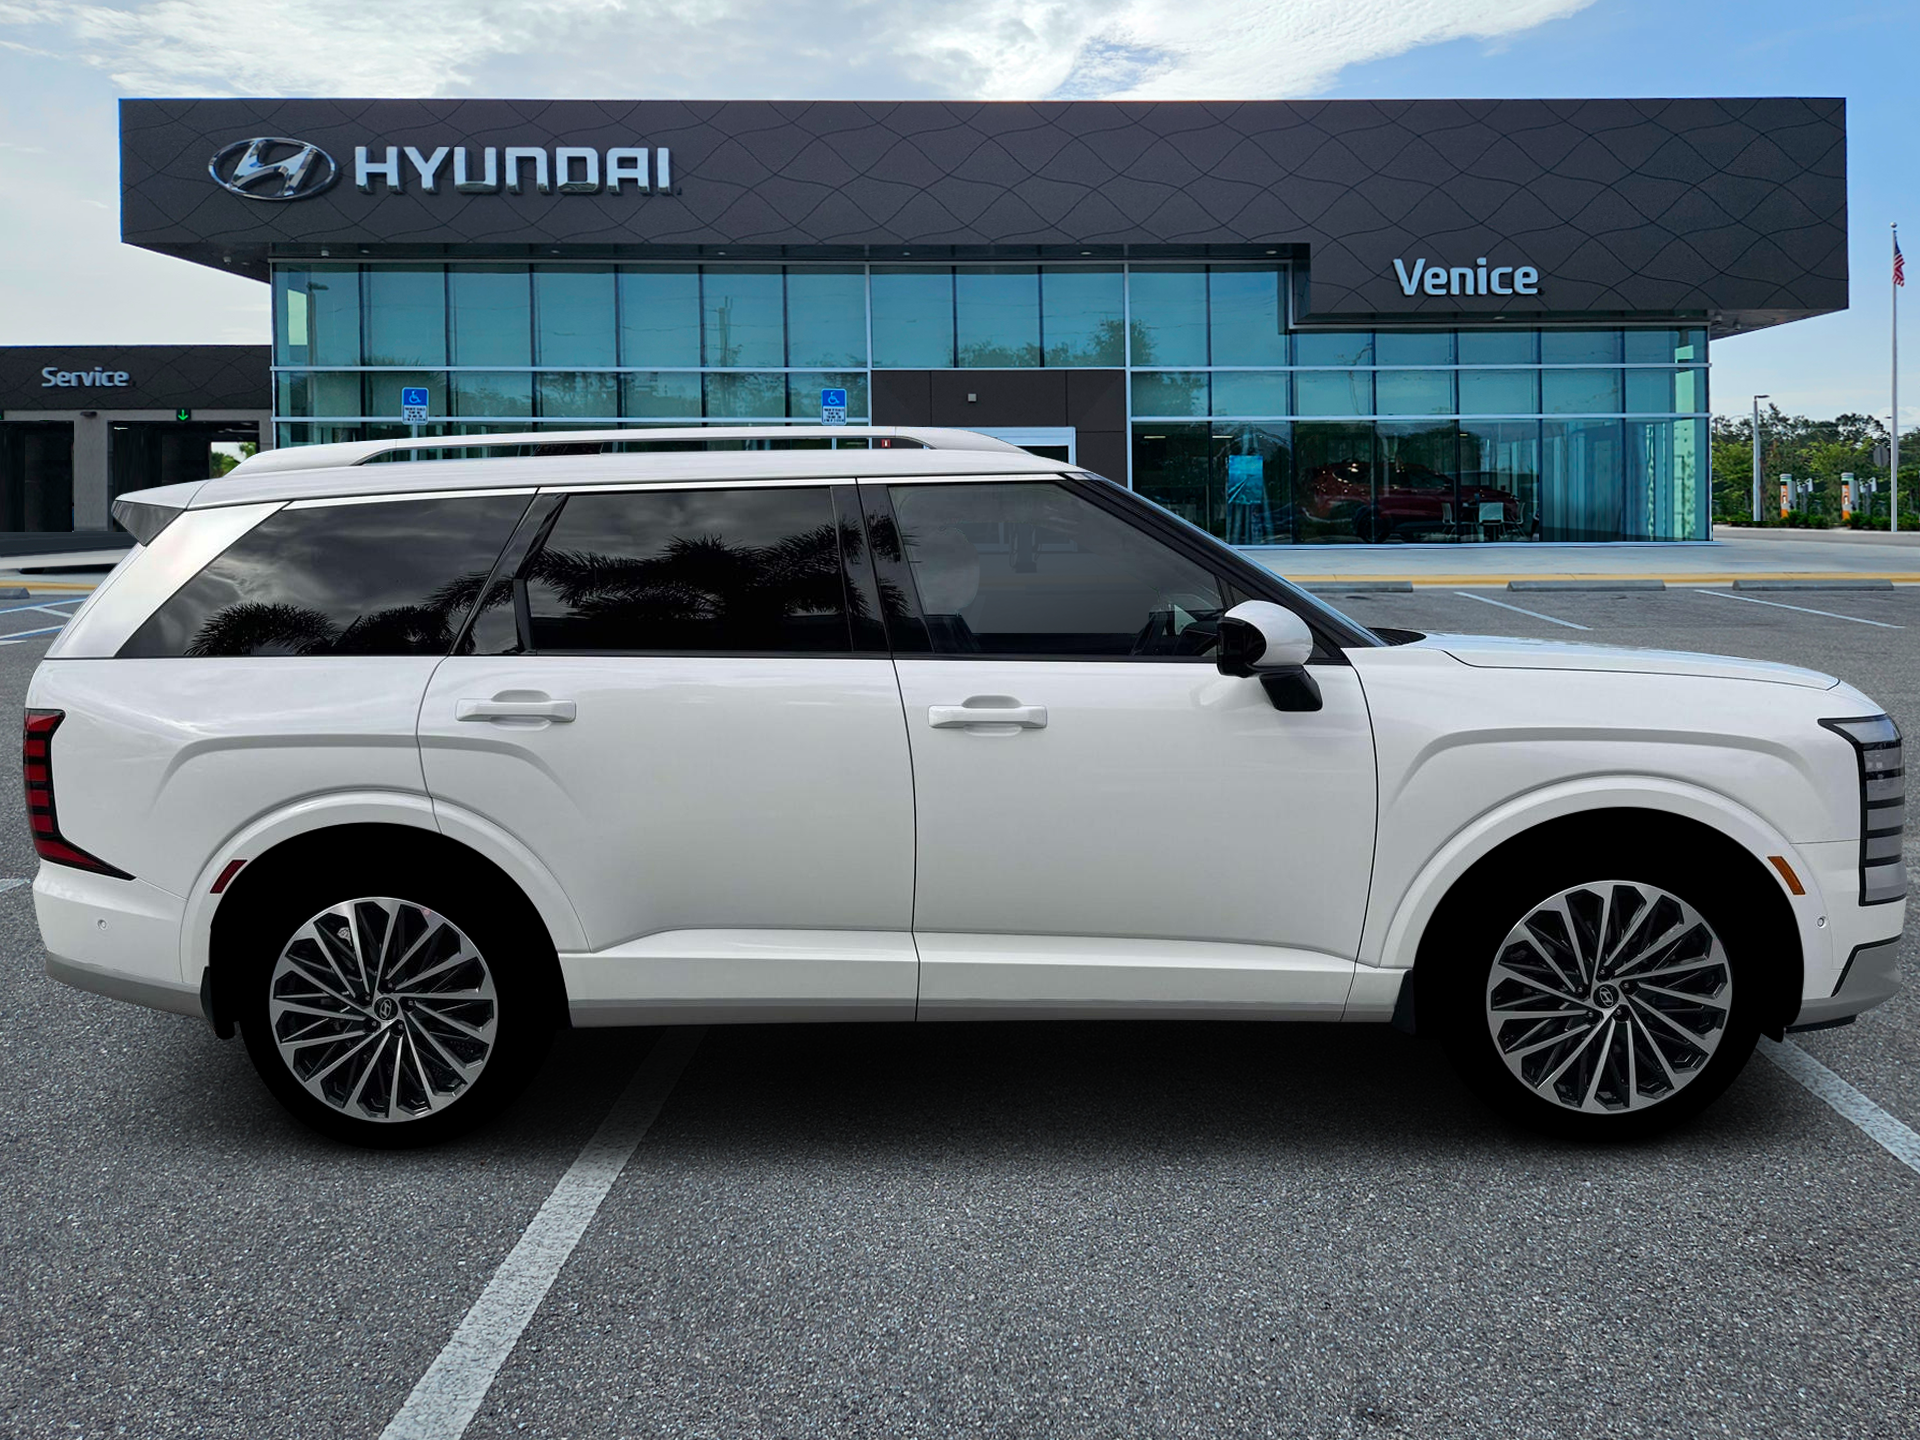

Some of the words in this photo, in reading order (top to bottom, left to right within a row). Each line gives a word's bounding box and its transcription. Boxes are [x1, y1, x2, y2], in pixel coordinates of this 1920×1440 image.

[354, 146, 673, 195] HYUNDAI
[1392, 256, 1539, 296] Venice
[41, 366, 130, 388] Service
